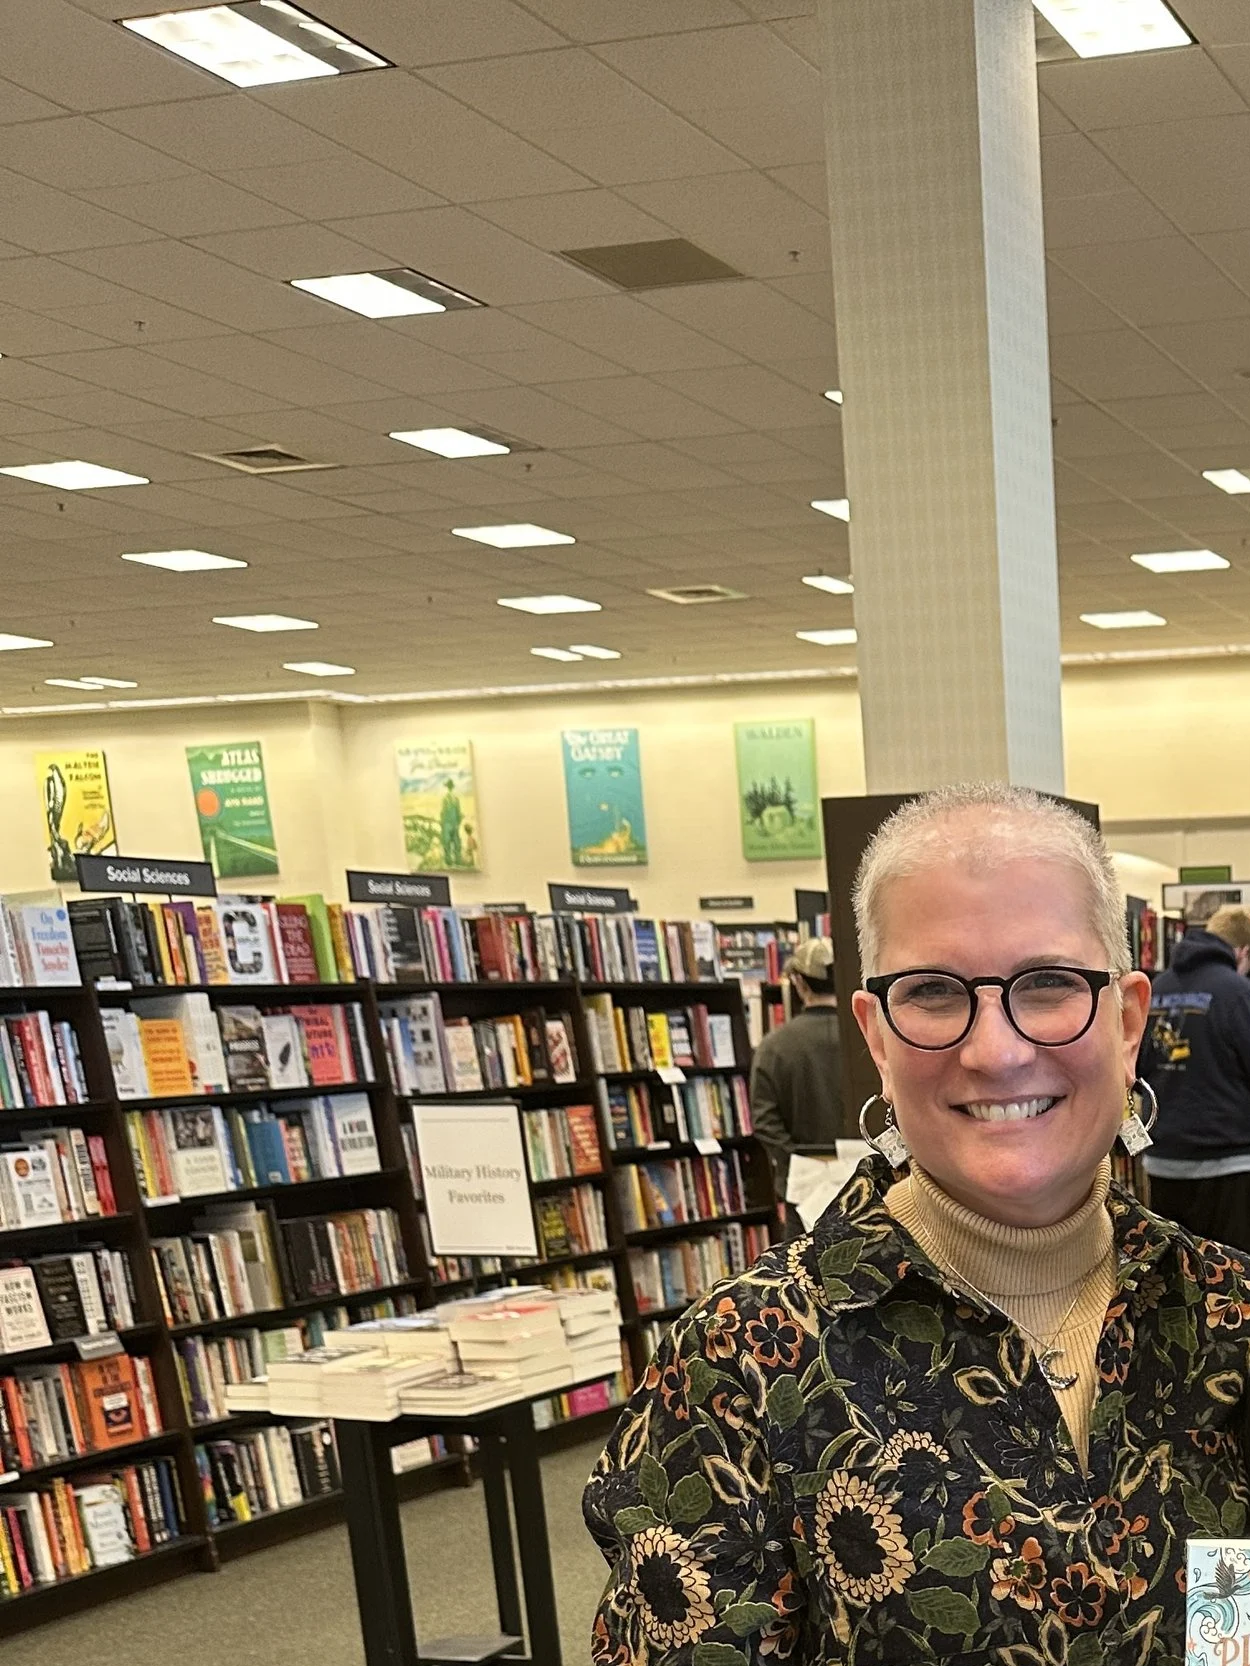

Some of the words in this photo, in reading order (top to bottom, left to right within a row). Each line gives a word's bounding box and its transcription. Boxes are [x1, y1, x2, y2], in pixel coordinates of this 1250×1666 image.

[221, 749, 260, 768] ATLAS
[106, 865, 141, 884] Social
[142, 867, 191, 886] Sciences
[367, 879, 394, 896] Social
[395, 881, 432, 898] Sciences
[424, 1164, 472, 1182] Military
[475, 1165, 522, 1182] History
[448, 1190, 505, 1204] Favorites
